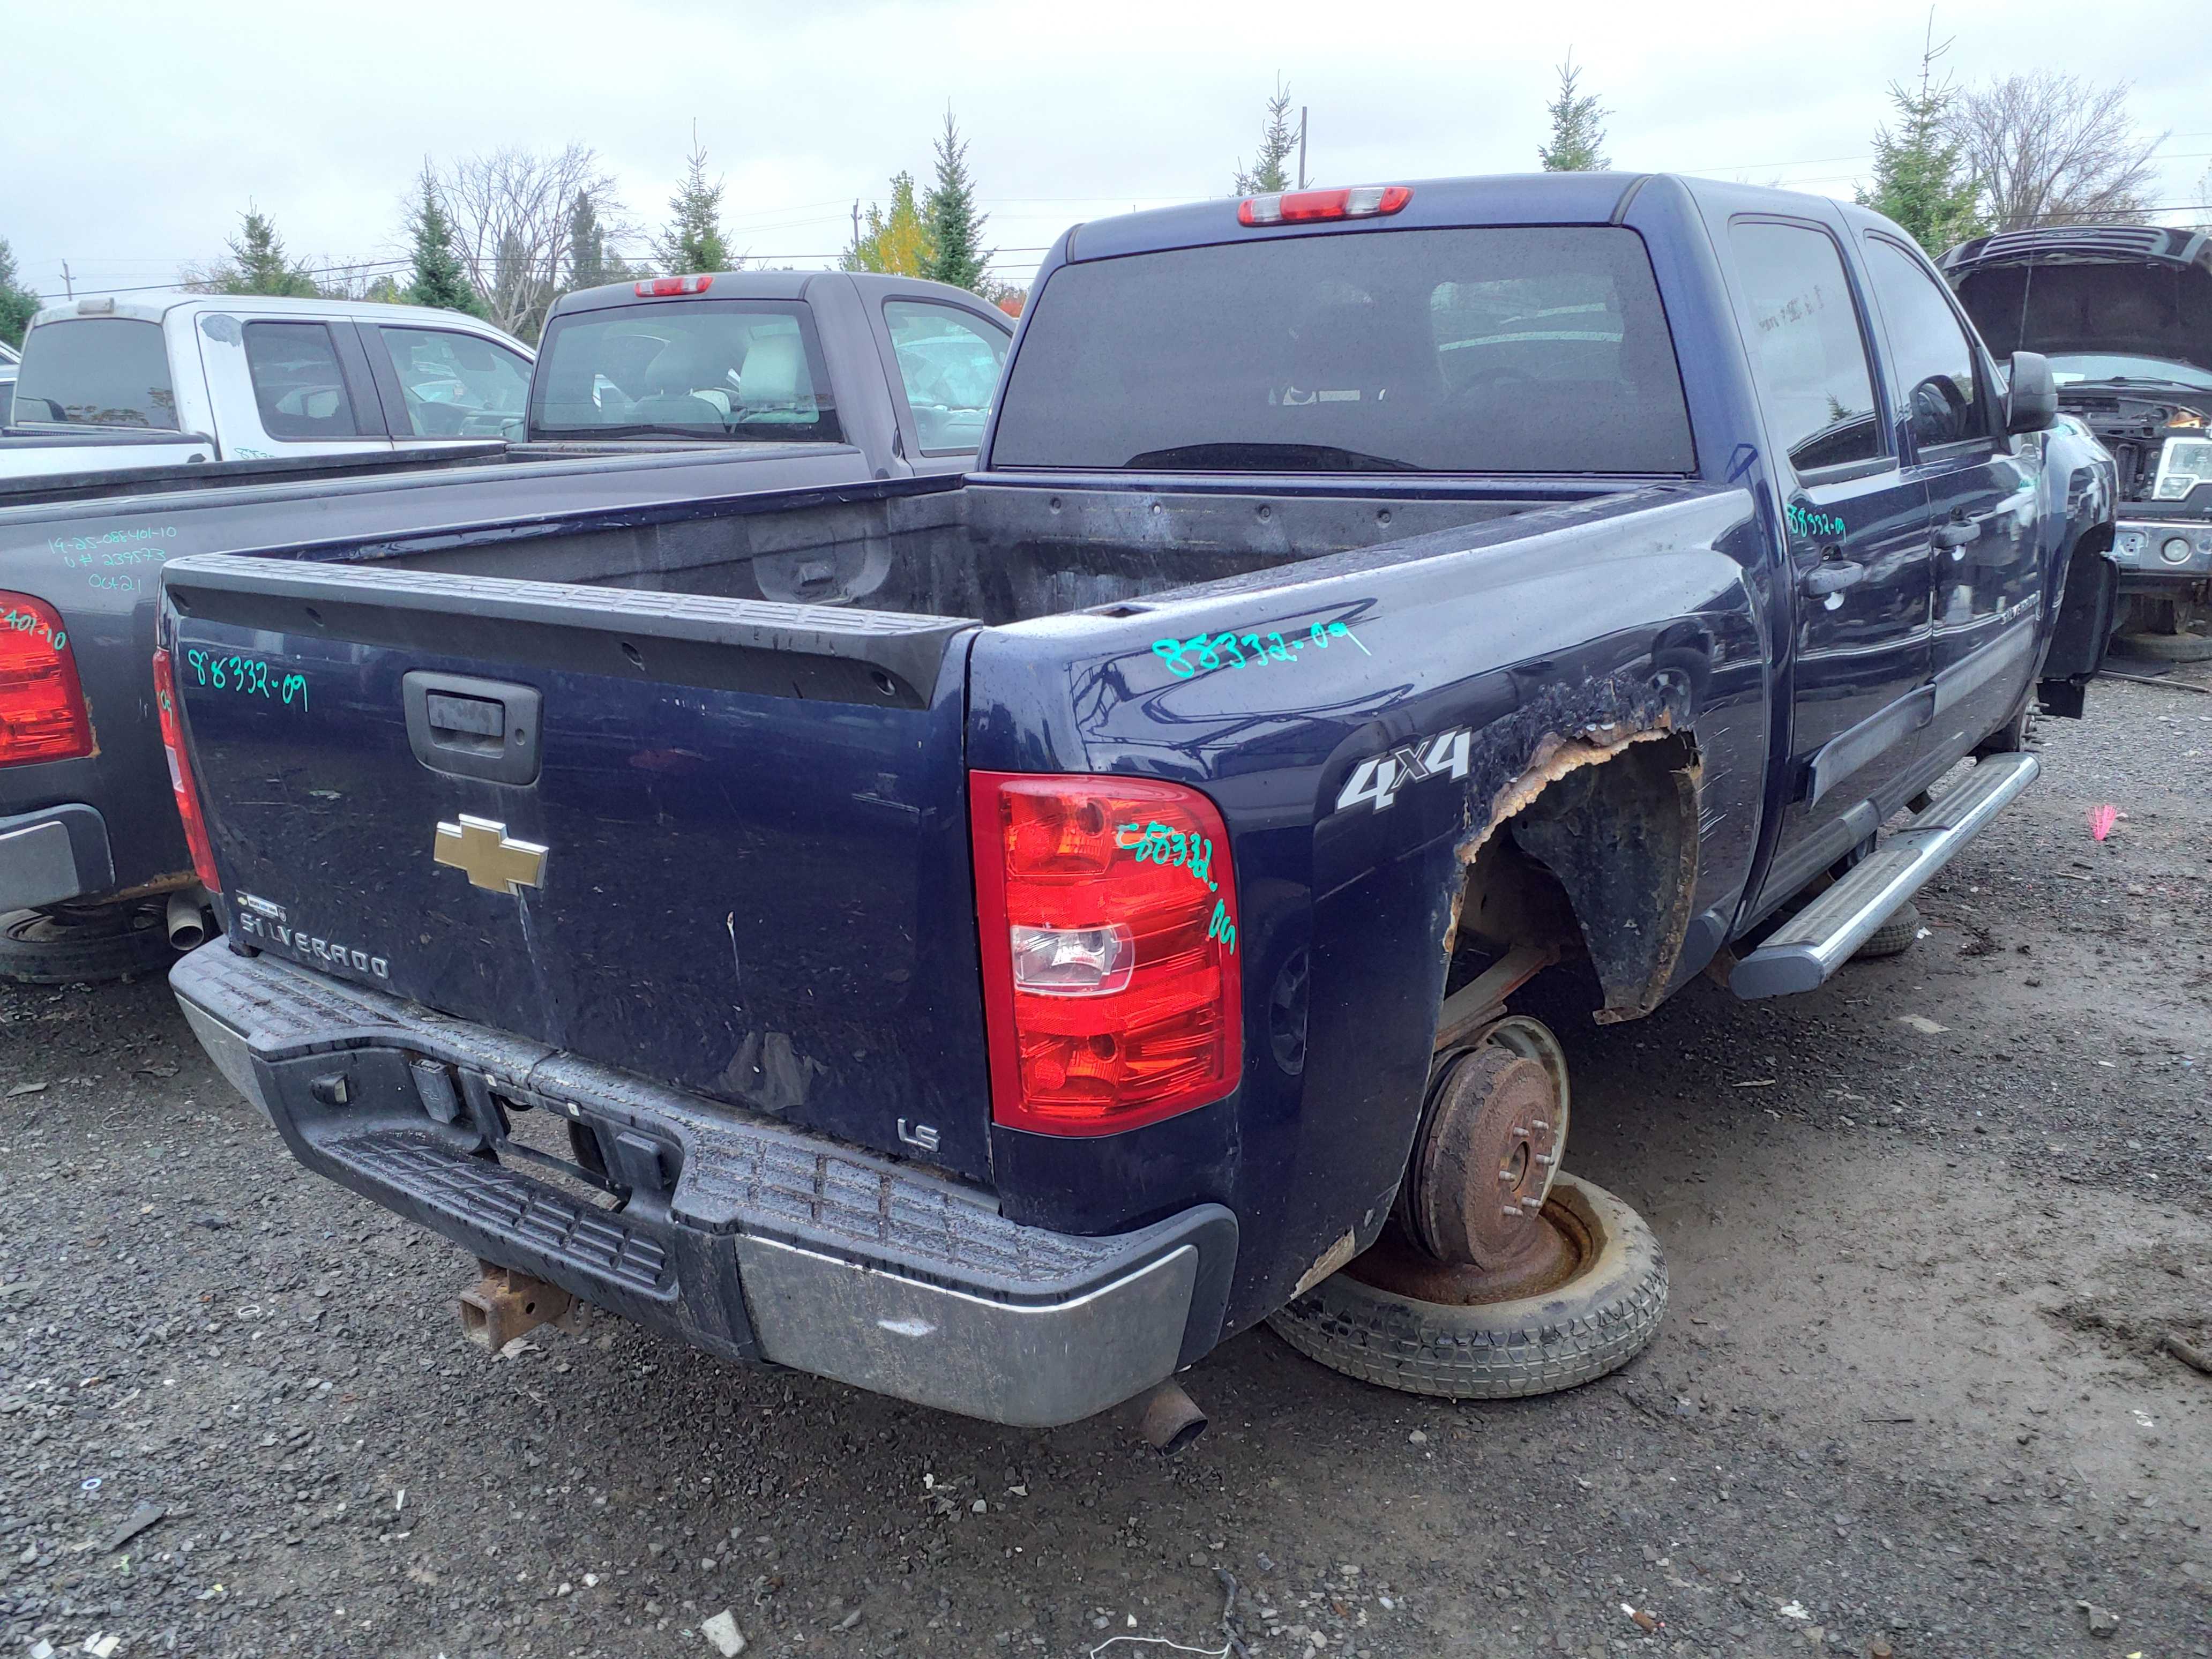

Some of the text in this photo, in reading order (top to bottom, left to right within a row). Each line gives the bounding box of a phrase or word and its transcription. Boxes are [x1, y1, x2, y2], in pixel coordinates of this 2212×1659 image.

[101, 548, 167, 566] 239573
[240, 912, 390, 980] SILVERADO
[897, 1117, 941, 1152] LS
